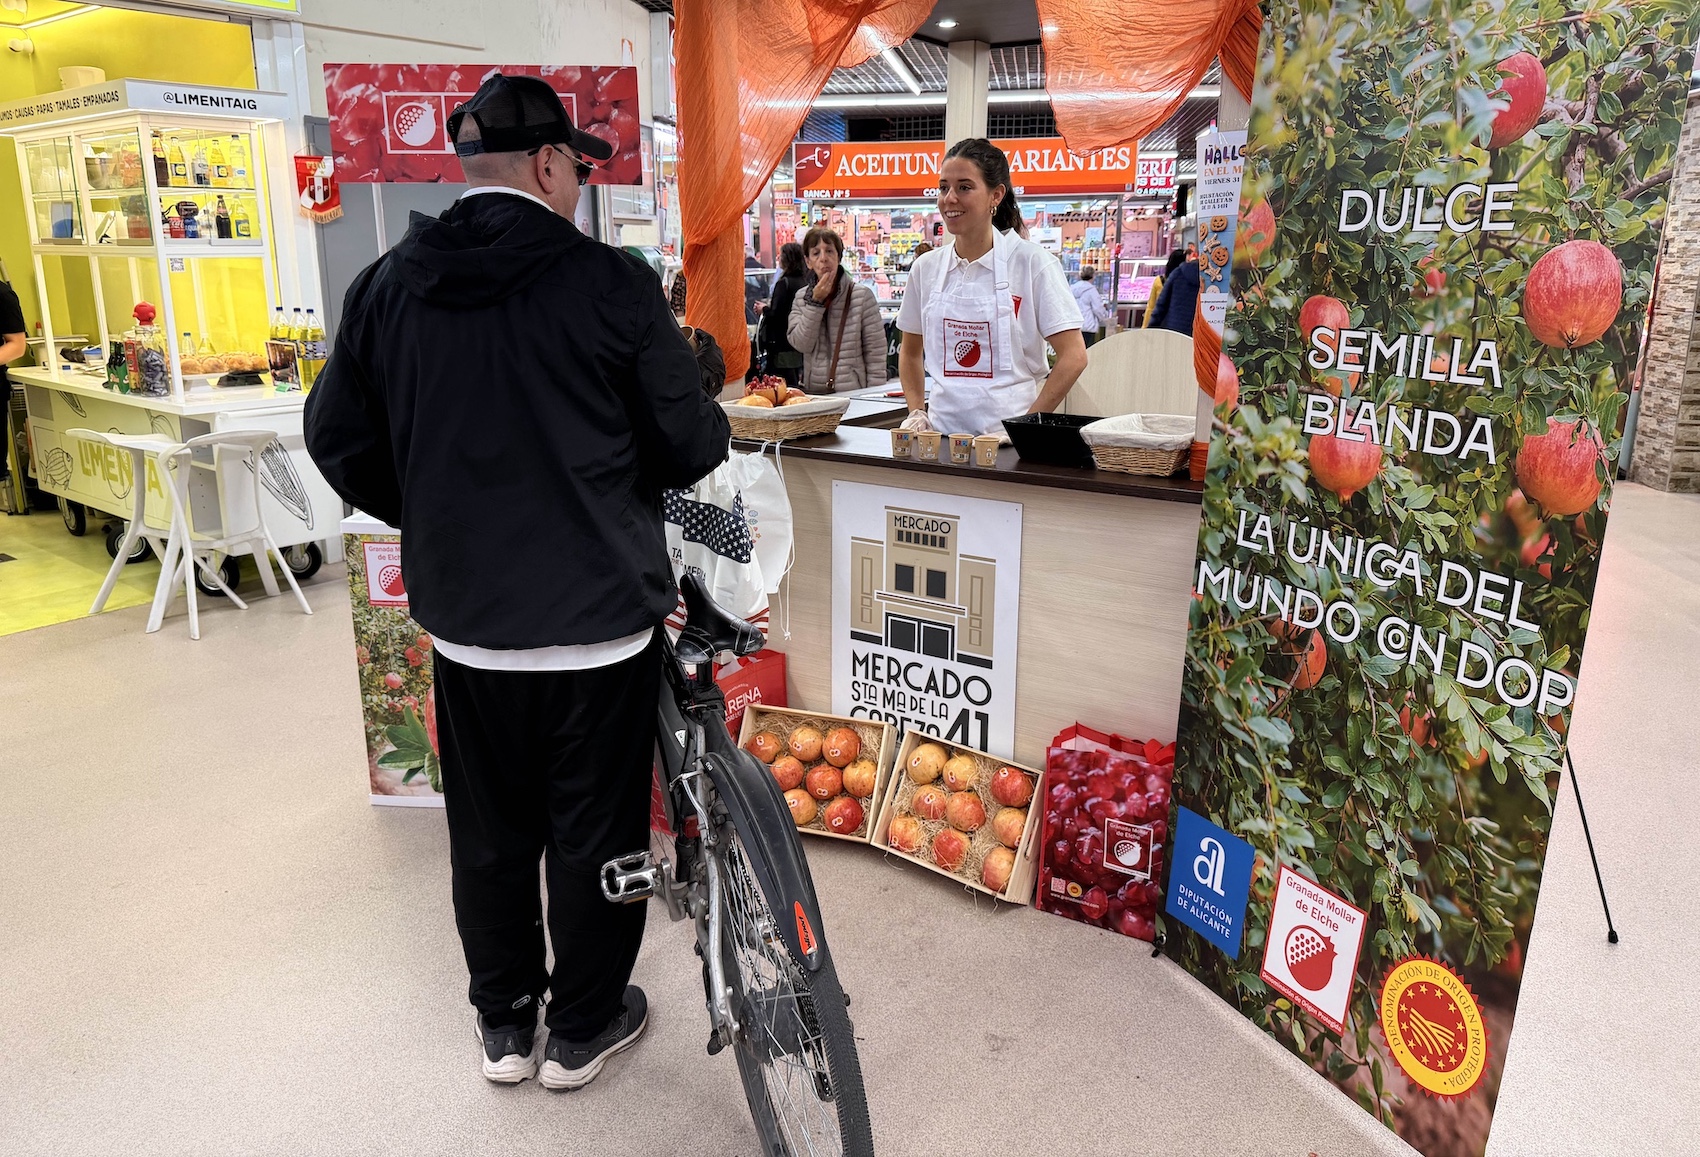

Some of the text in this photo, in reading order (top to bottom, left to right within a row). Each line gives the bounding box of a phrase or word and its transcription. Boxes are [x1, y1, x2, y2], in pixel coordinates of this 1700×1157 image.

[15, 106, 34, 119] CAUSAS
[36, 102, 54, 115] PAPAS
[55, 98, 80, 112] TAMALES
[82, 90, 120, 107] EMPANADAS
[162, 92, 258, 110] @LIMENITAIG
[835, 152, 942, 177] ACEITUN
[1216, 166, 1229, 176] EL
[803, 190, 831, 198] BANCA
[1338, 182, 1519, 234] DULCE
[1307, 326, 1504, 389] SEMILLA
[1301, 393, 1498, 467] BLANDA
[894, 515, 951, 534] MERCADO
[1236, 509, 1277, 557] LA
[1435, 558, 1542, 634] DEL
[1196, 560, 1362, 646] MUNDO
[1455, 638, 1574, 716] DOP
[852, 649, 992, 706] MERCADO
[728, 686, 762, 714] REINA
[852, 680, 878, 706] STA
[910, 695, 926, 715] DE
[931, 700, 948, 720] LA
[1177, 896, 1231, 939] DE ALICANTE
[1178, 884, 1232, 926] DIPUTACIÓN
[1286, 876, 1356, 925] Granada Mollar
[1295, 899, 1339, 932] de Elche
[1262, 971, 1295, 999] Denominación
[1301, 1000, 1318, 1016] Origen
[1317, 1012, 1342, 1033] Protegida
[1385, 964, 1481, 1088] DENOMINACIÓN DE ORIGEN PROTEGIDA
